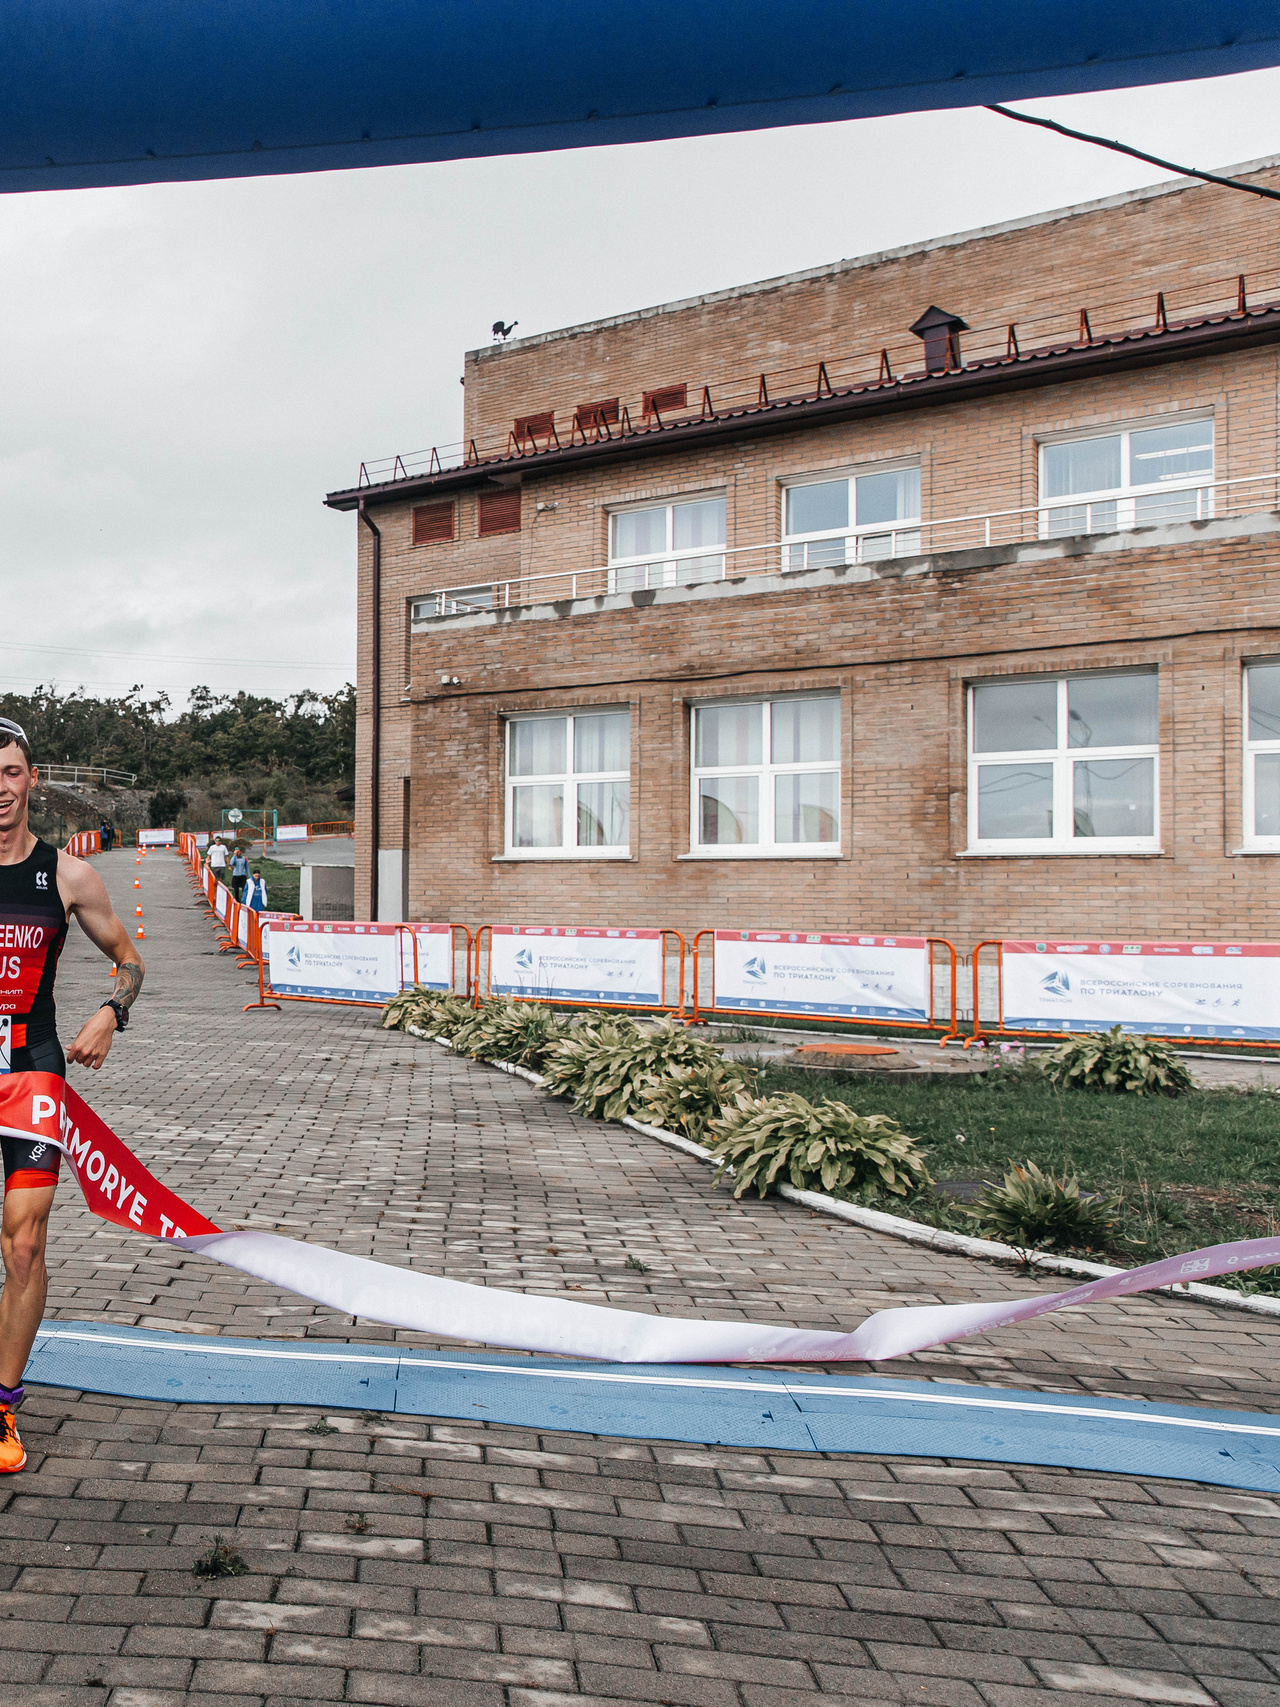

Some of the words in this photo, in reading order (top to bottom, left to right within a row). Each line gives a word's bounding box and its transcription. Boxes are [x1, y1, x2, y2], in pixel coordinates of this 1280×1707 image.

[788, 973, 836, 981] ТРИАТЛОНУ
[1080, 979, 1160, 988] ВСЕРОССИЙСКИЕ
[1163, 981, 1243, 989] СОРЕВНОВАНИЯ
[1100, 988, 1163, 997] ТРИАТЛОНУ
